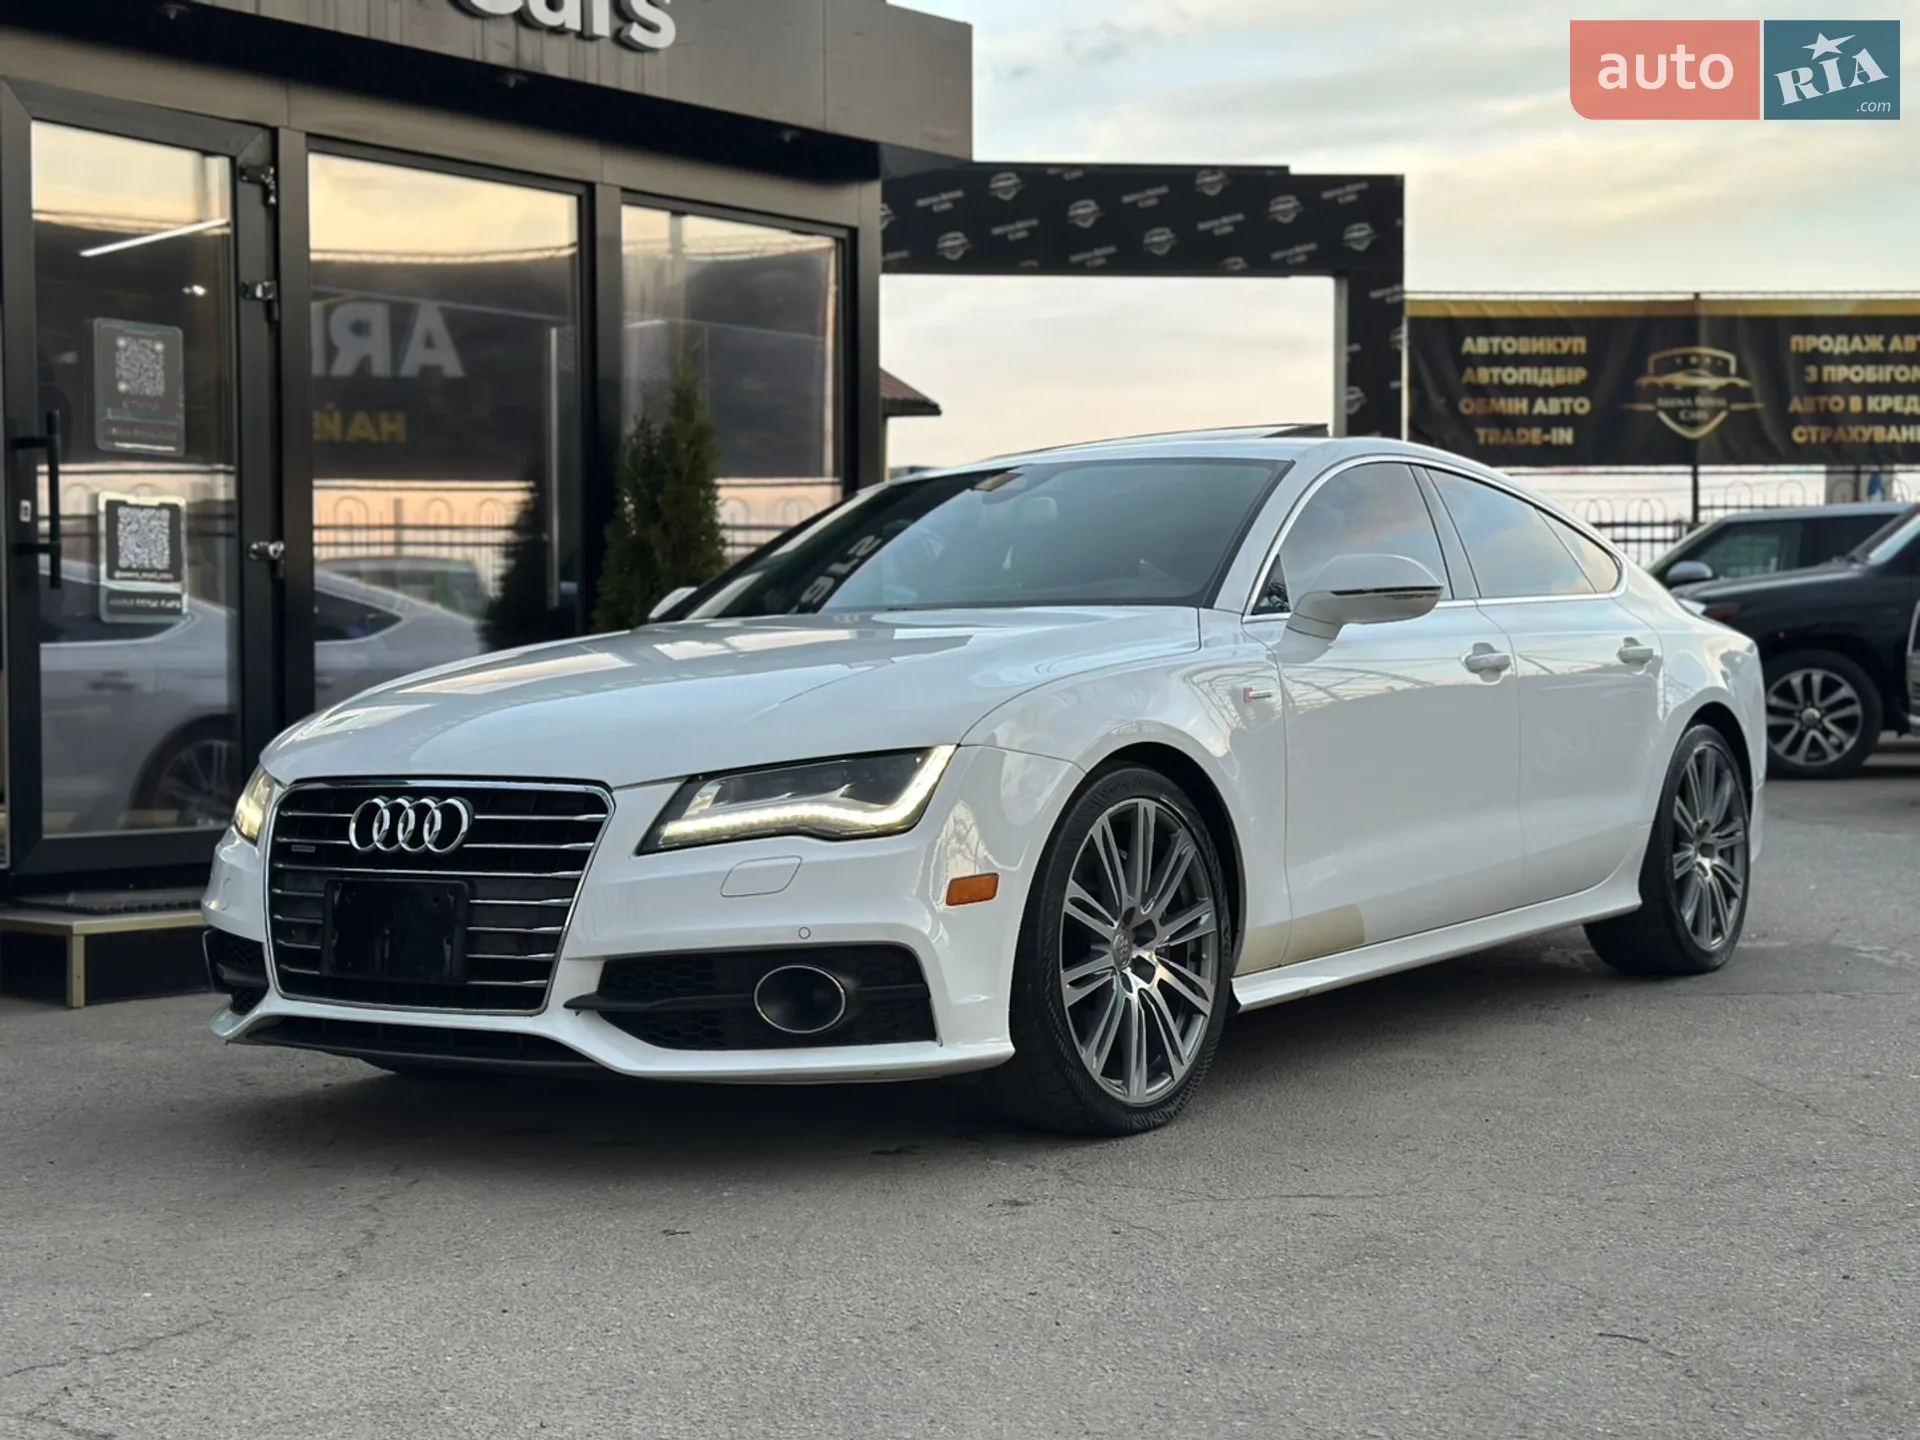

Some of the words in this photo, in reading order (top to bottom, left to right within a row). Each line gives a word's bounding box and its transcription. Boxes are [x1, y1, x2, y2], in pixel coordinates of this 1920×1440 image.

[1461, 335, 1587, 354] АВТОВИКУП
[1790, 334, 1884, 355] ПРОДАЖ
[1461, 366, 1588, 387] АВТОПІДБІР
[1458, 396, 1529, 415] ОБМІН
[1532, 396, 1591, 415] АВТО
[1788, 394, 1846, 414] АВТО
[1475, 427, 1574, 445] TRADE-IN
